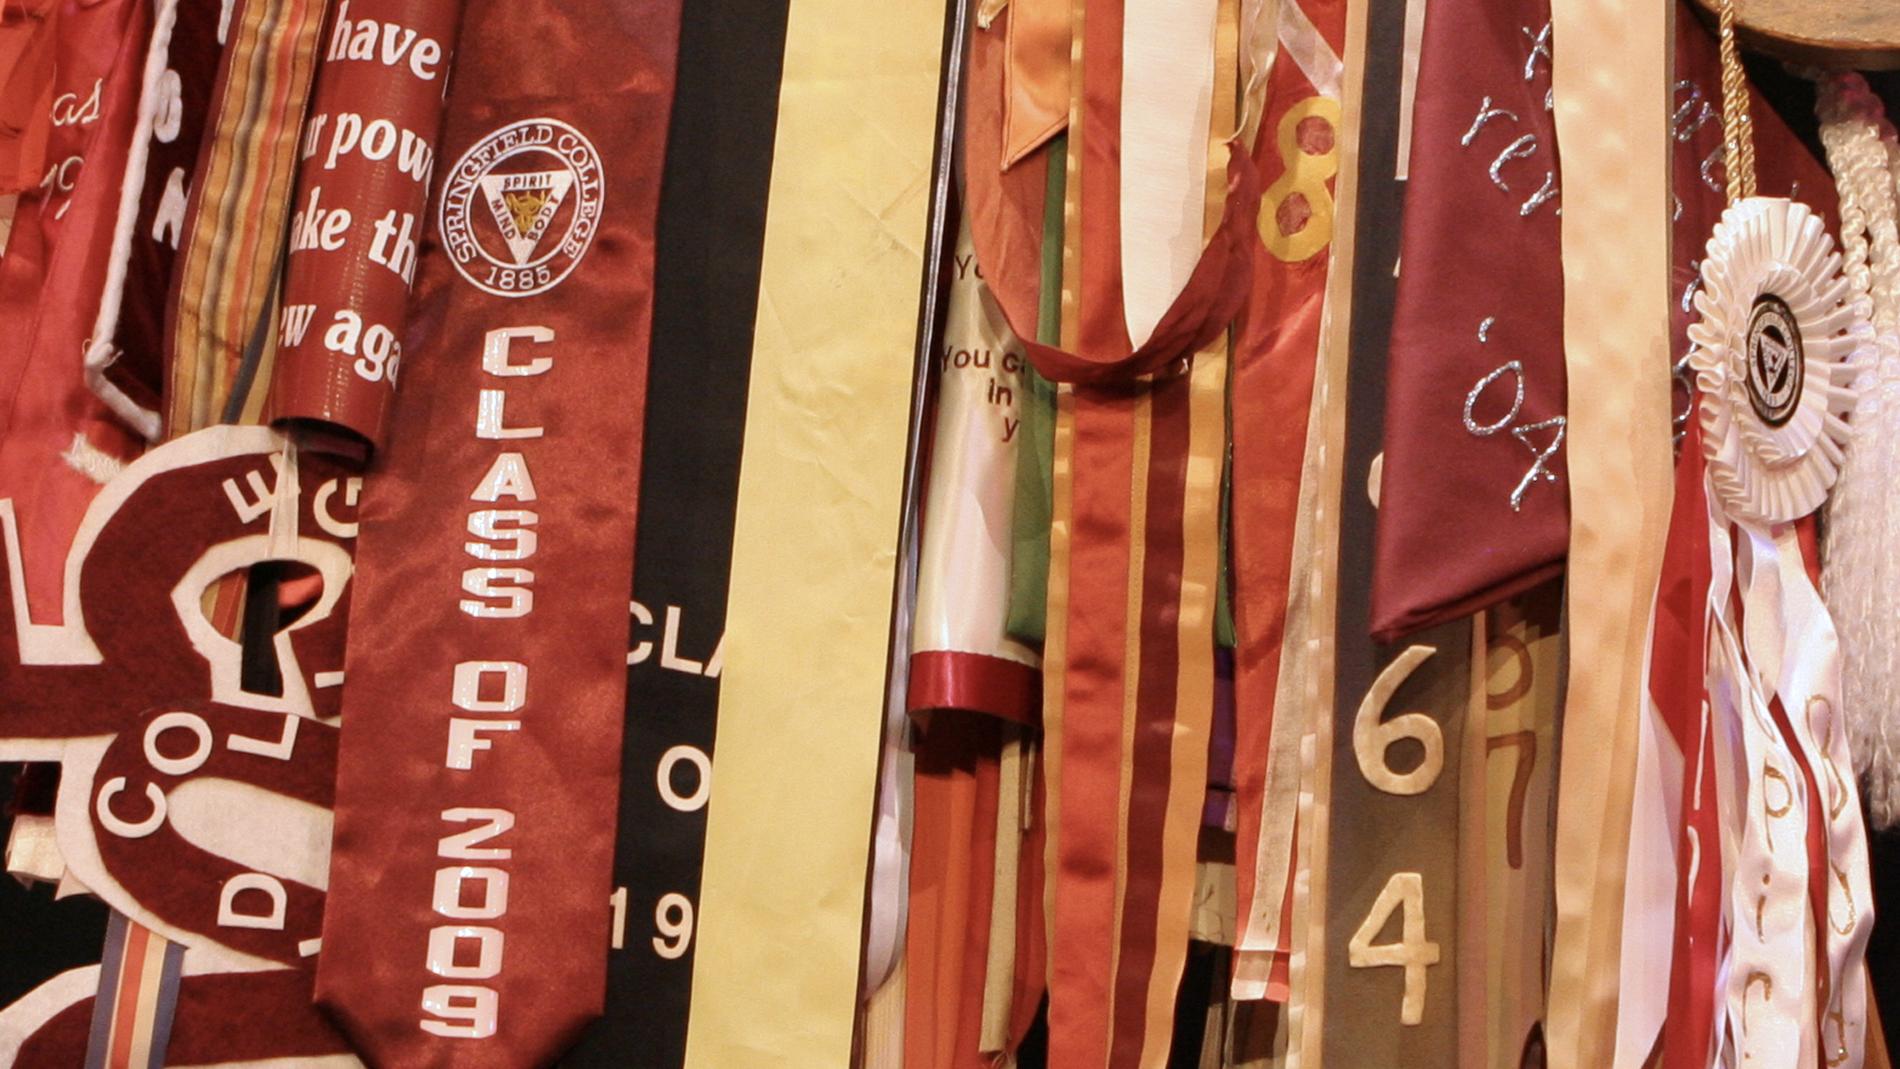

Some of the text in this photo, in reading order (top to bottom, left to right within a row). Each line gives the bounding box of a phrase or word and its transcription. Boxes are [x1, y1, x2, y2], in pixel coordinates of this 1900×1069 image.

[327, 0, 441, 81] have
[446, 125, 600, 264] SPRINGFIELD COLLEGE
[503, 174, 552, 188] SPIRIT
[492, 198, 516, 240] MIND
[527, 195, 560, 241] BODY
[484, 265, 551, 290] 1885
[419, 326, 555, 1040] CLASS OF 2009
